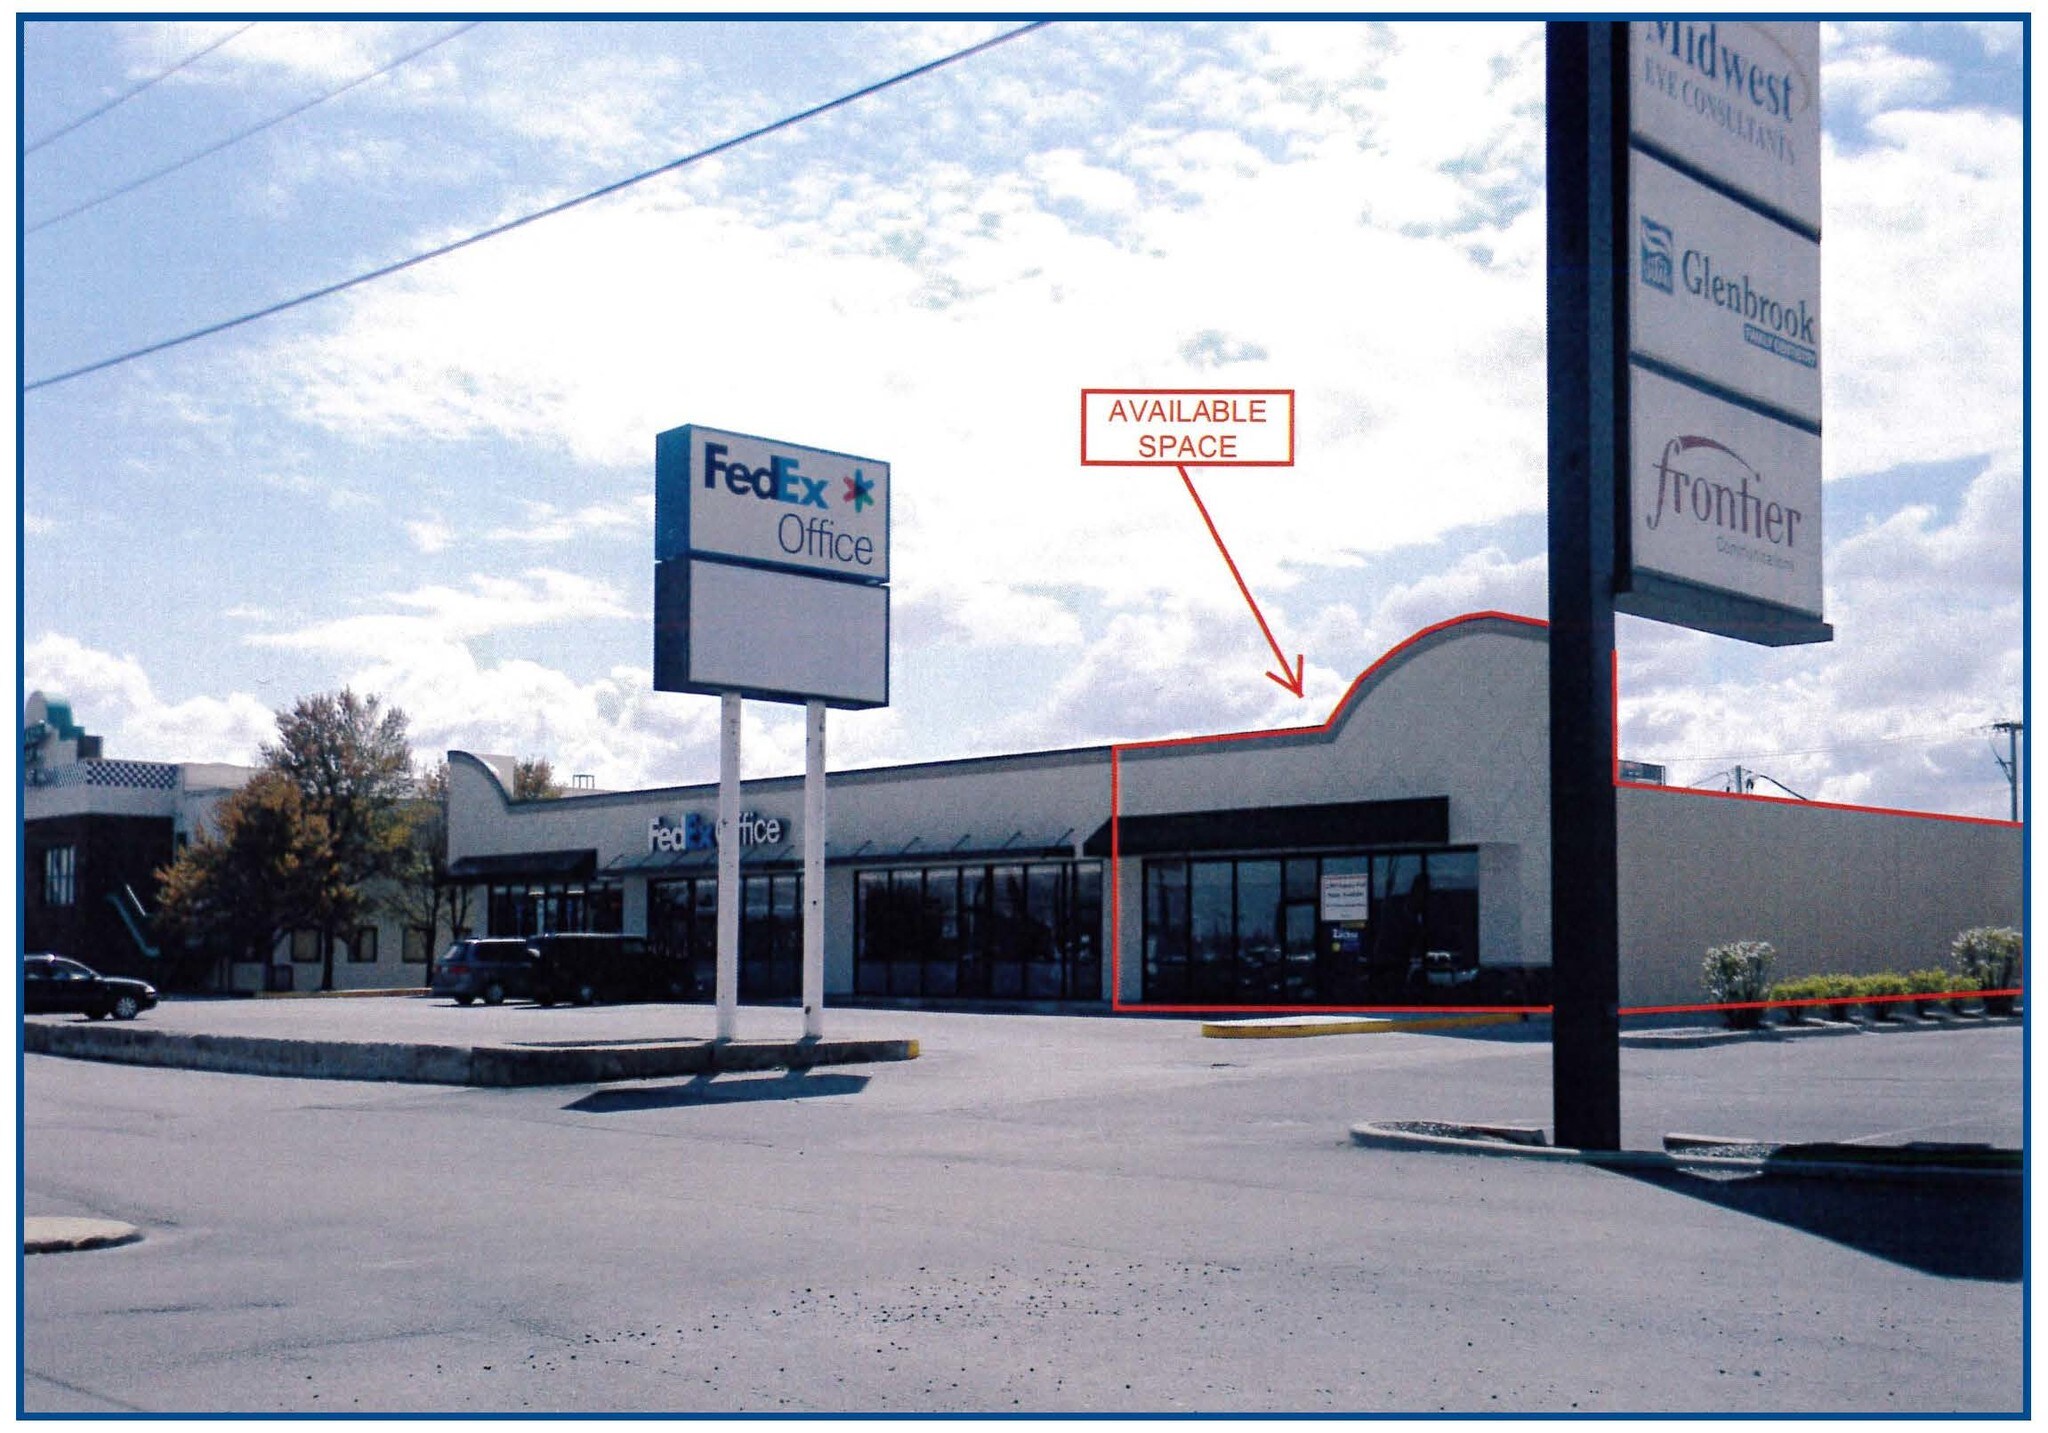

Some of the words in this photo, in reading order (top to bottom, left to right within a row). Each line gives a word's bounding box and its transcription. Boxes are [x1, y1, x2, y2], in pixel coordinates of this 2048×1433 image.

[1646, 21, 1794, 123] Midwest
[1682, 249, 1817, 345] Glenbrook
[705, 441, 829, 510] FedEx
[1646, 434, 1802, 548] frontier
[778, 513, 874, 566] Office
[648, 810, 714, 851] FedEx
[715, 811, 780, 846] fice
